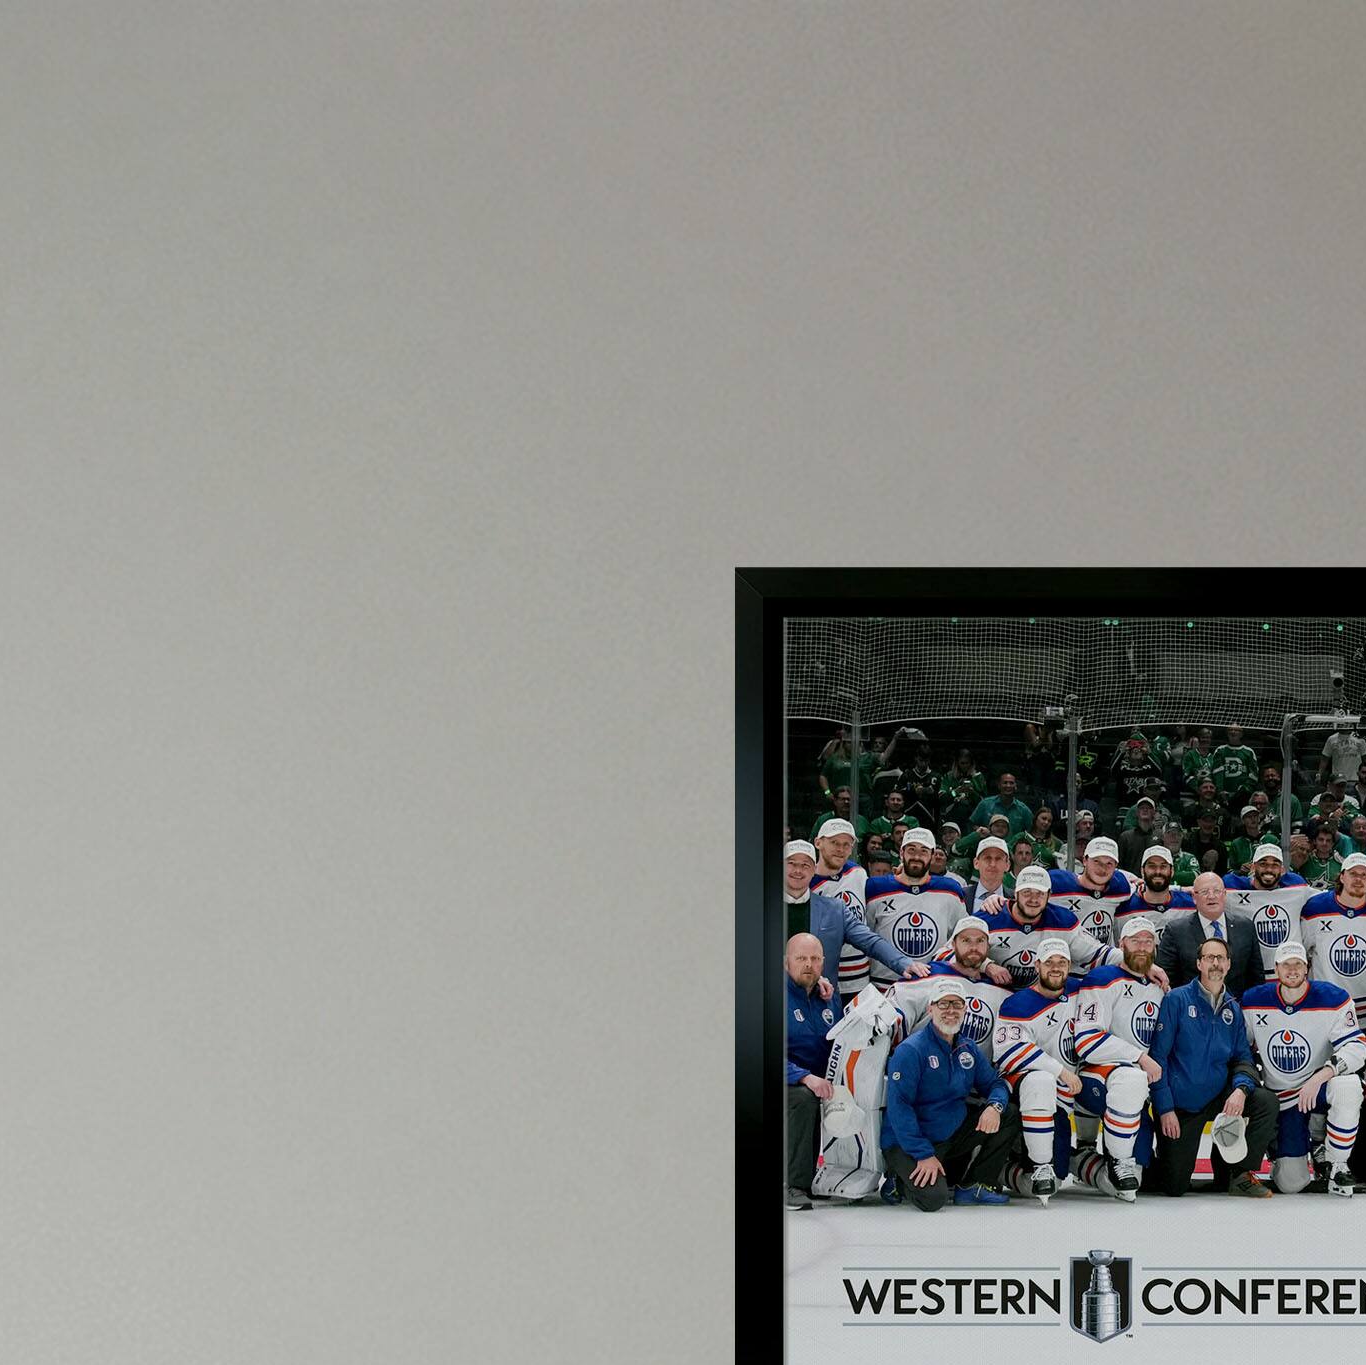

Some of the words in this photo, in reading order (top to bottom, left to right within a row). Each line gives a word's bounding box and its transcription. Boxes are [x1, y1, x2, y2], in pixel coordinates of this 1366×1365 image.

[898, 928, 933, 956] OILERS
[1256, 919, 1287, 945] OILERS
[1335, 949, 1366, 974] OILERS
[960, 1011, 989, 1040] ILERS
[1076, 1003, 1097, 1022] 14
[996, 1026, 1022, 1044] 33
[826, 1043, 841, 1084] AUGHN
[1272, 1045, 1306, 1071] OILERS
[842, 1279, 1060, 1315] WESTERN
